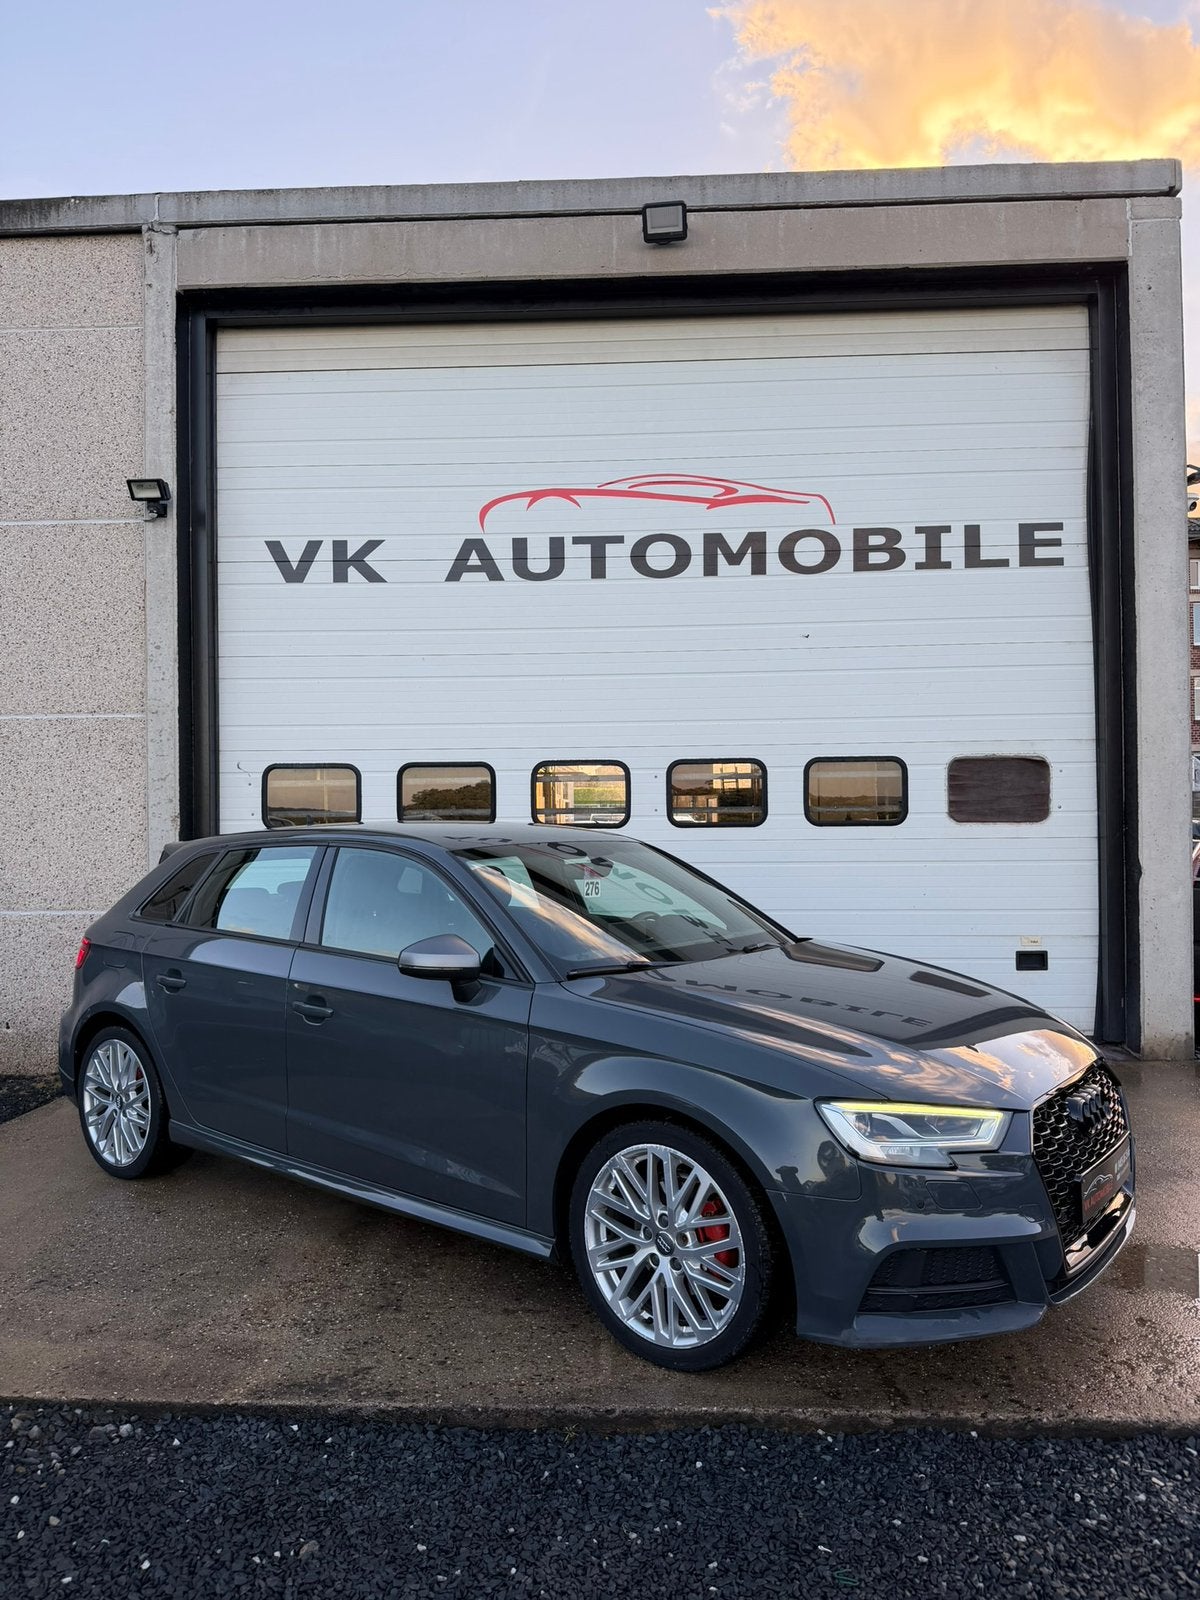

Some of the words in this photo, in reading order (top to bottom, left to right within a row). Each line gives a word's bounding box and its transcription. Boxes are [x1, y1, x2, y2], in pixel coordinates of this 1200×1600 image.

[264, 539, 388, 583] VK
[444, 522, 1065, 582] AUTOMOBILE
[584, 881, 600, 897] 276
